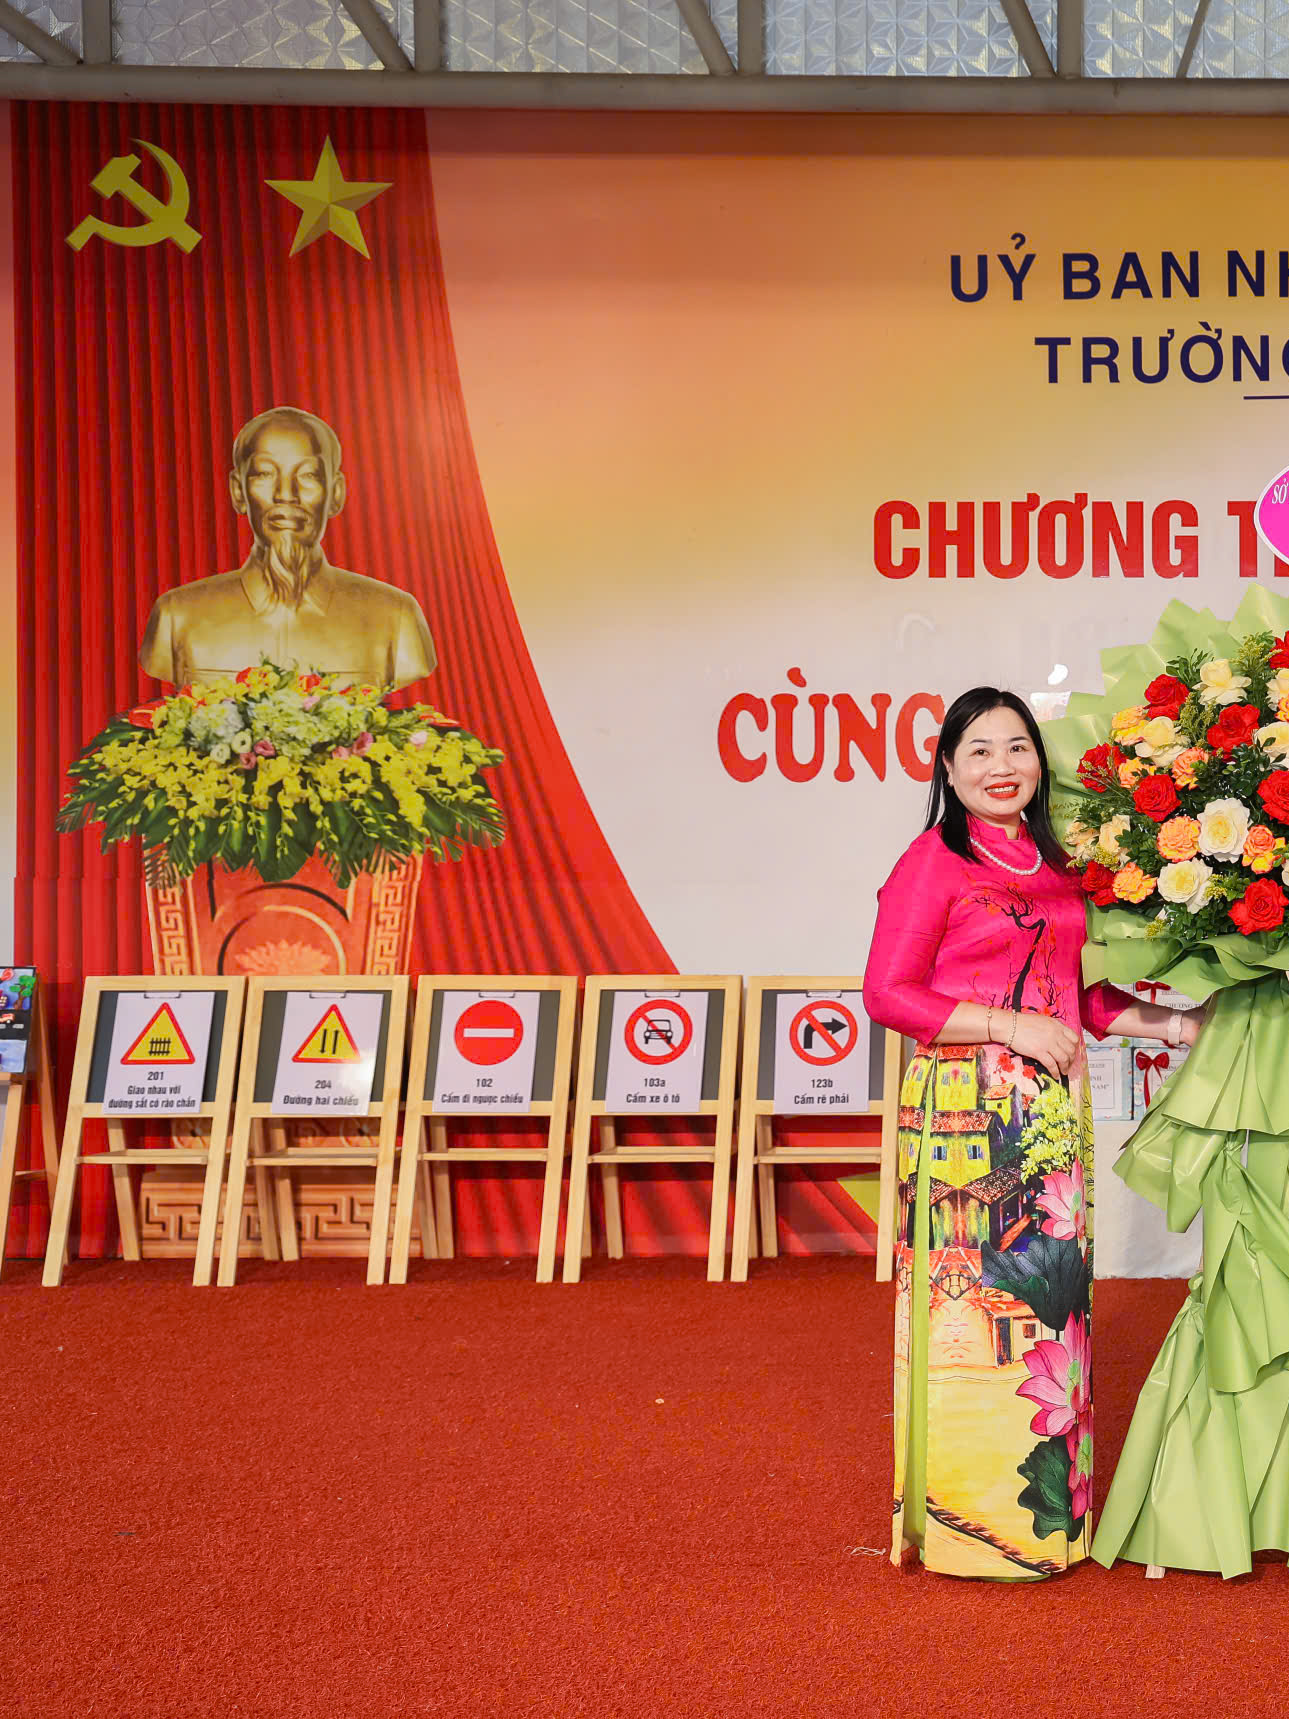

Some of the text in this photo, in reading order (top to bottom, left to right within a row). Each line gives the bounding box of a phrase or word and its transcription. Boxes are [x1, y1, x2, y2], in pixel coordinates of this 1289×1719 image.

[950, 233, 1036, 302] UỶ
[1061, 251, 1200, 300] BAN
[1271, 477, 1289, 505] SỞ
[873, 492, 1199, 580] CHƯƠNG
[717, 666, 944, 783] CÙNG
[147, 1071, 164, 1081] 201
[314, 1080, 332, 1089] 204
[476, 1078, 493, 1088] 102
[644, 1078, 666, 1088] 103a
[811, 1078, 834, 1088] 123b
[127, 1085, 145, 1095] Giao
[147, 1085, 167, 1095] nhau
[315, 1095, 330, 1105] hai
[441, 1092, 460, 1103] Cấm
[462, 1093, 471, 1103] đi
[626, 1092, 647, 1103] Cấm
[649, 1095, 661, 1103] xe
[671, 1093, 681, 1103] tô
[794, 1093, 814, 1104] Cấm
[829, 1092, 849, 1104] phải
